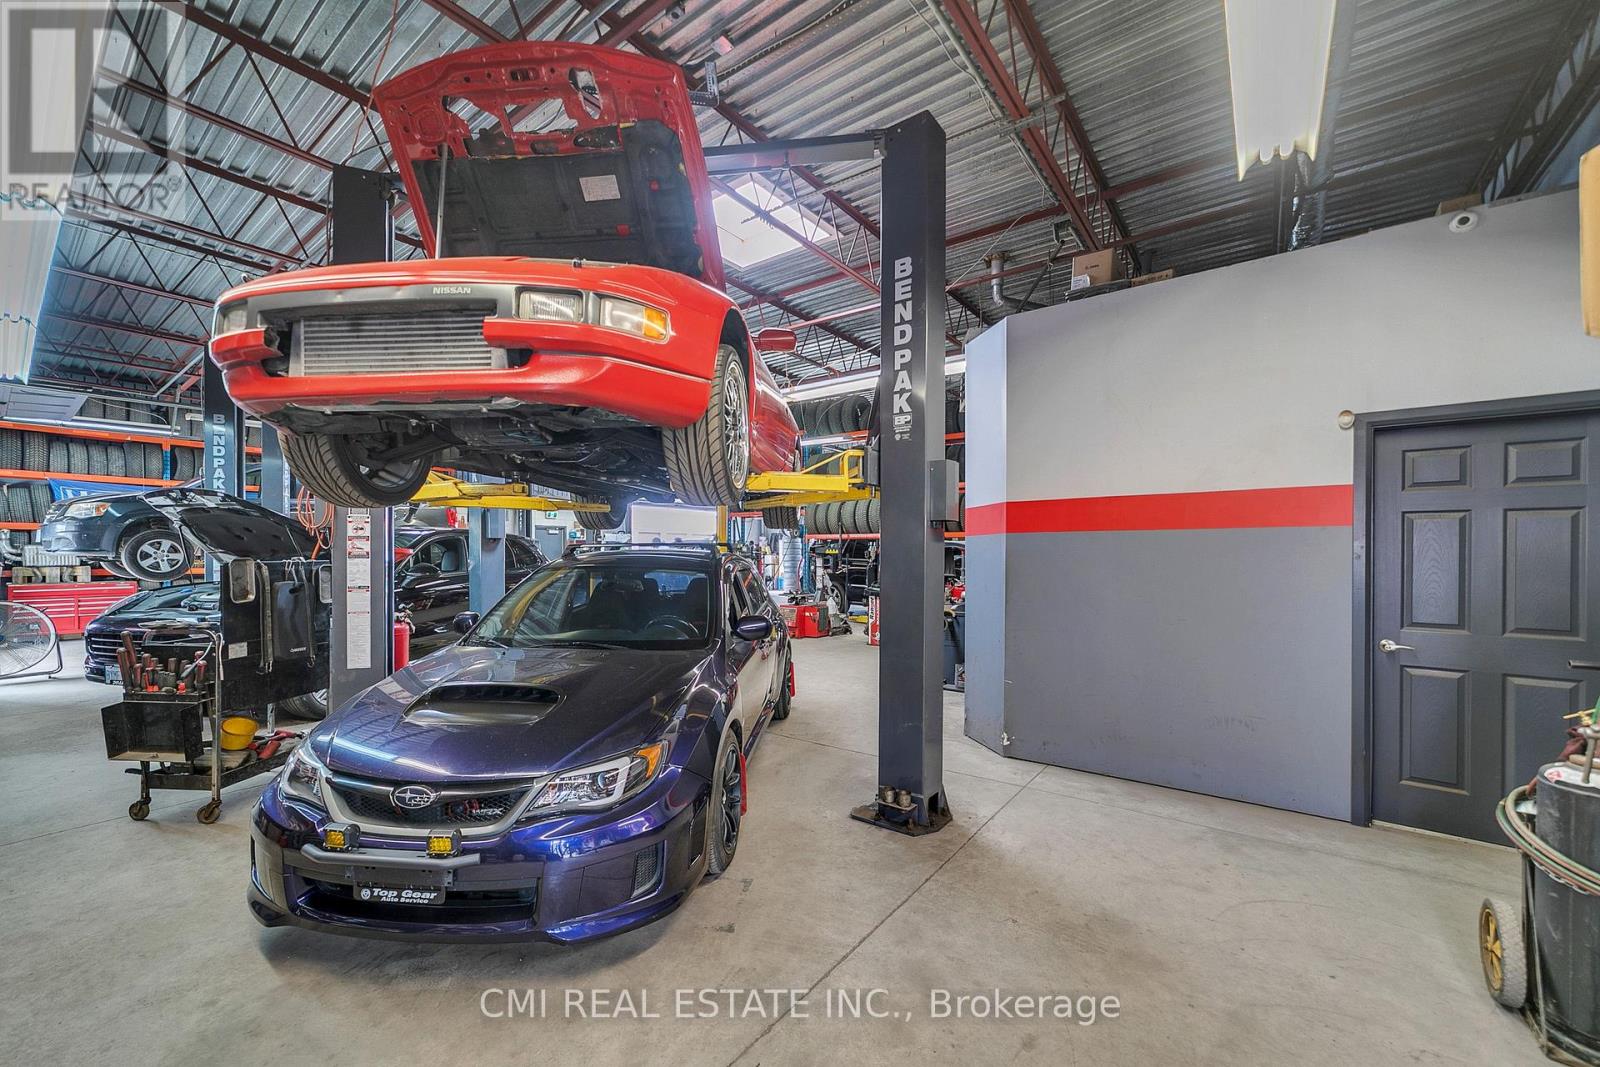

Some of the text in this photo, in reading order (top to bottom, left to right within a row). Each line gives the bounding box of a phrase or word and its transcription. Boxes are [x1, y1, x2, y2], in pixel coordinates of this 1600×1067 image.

[432, 286, 471, 295] NISSAN
[893, 256, 912, 413] BENDPAK
[372, 888, 437, 899] Top Gear
